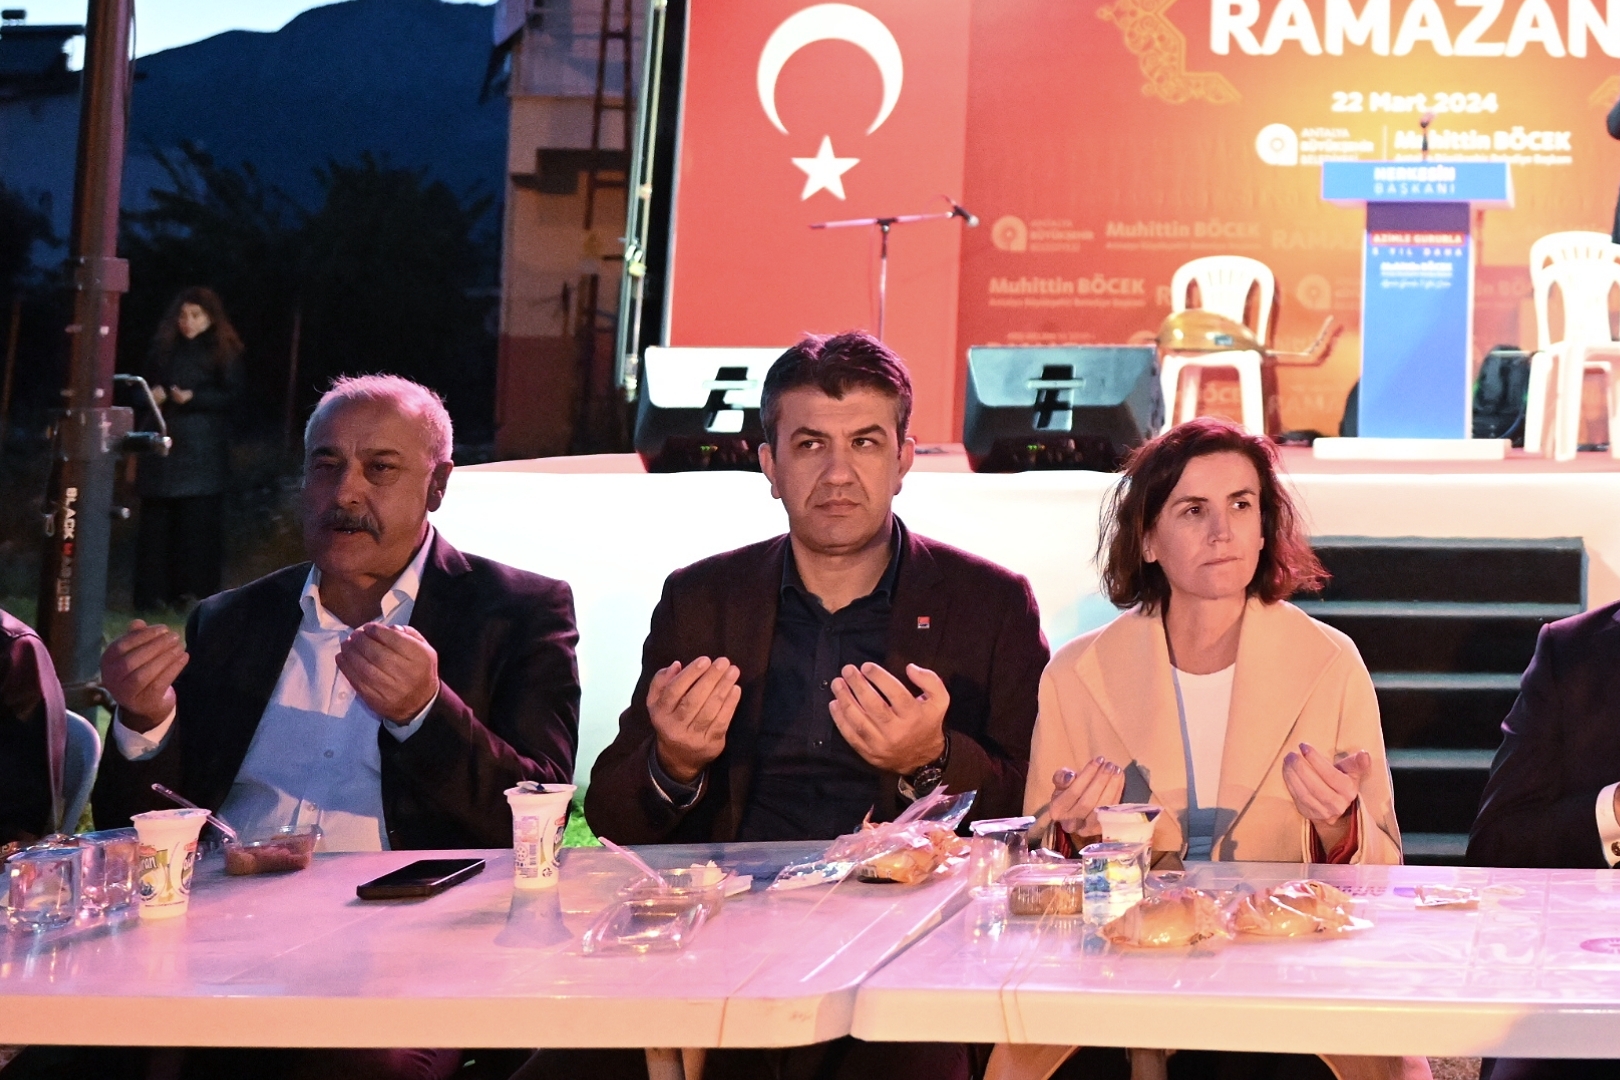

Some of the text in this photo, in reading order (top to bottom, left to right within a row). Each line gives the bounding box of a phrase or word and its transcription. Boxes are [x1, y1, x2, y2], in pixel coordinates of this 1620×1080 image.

[1331, 91, 1499, 114] 22 Mart 2024
[1493, 126, 1572, 152] BÖCEK
[1106, 219, 1261, 238] Muhittin BÖCEK
[989, 273, 1145, 294] Muhittin BÖCEK
[63, 487, 78, 540] BLACK
